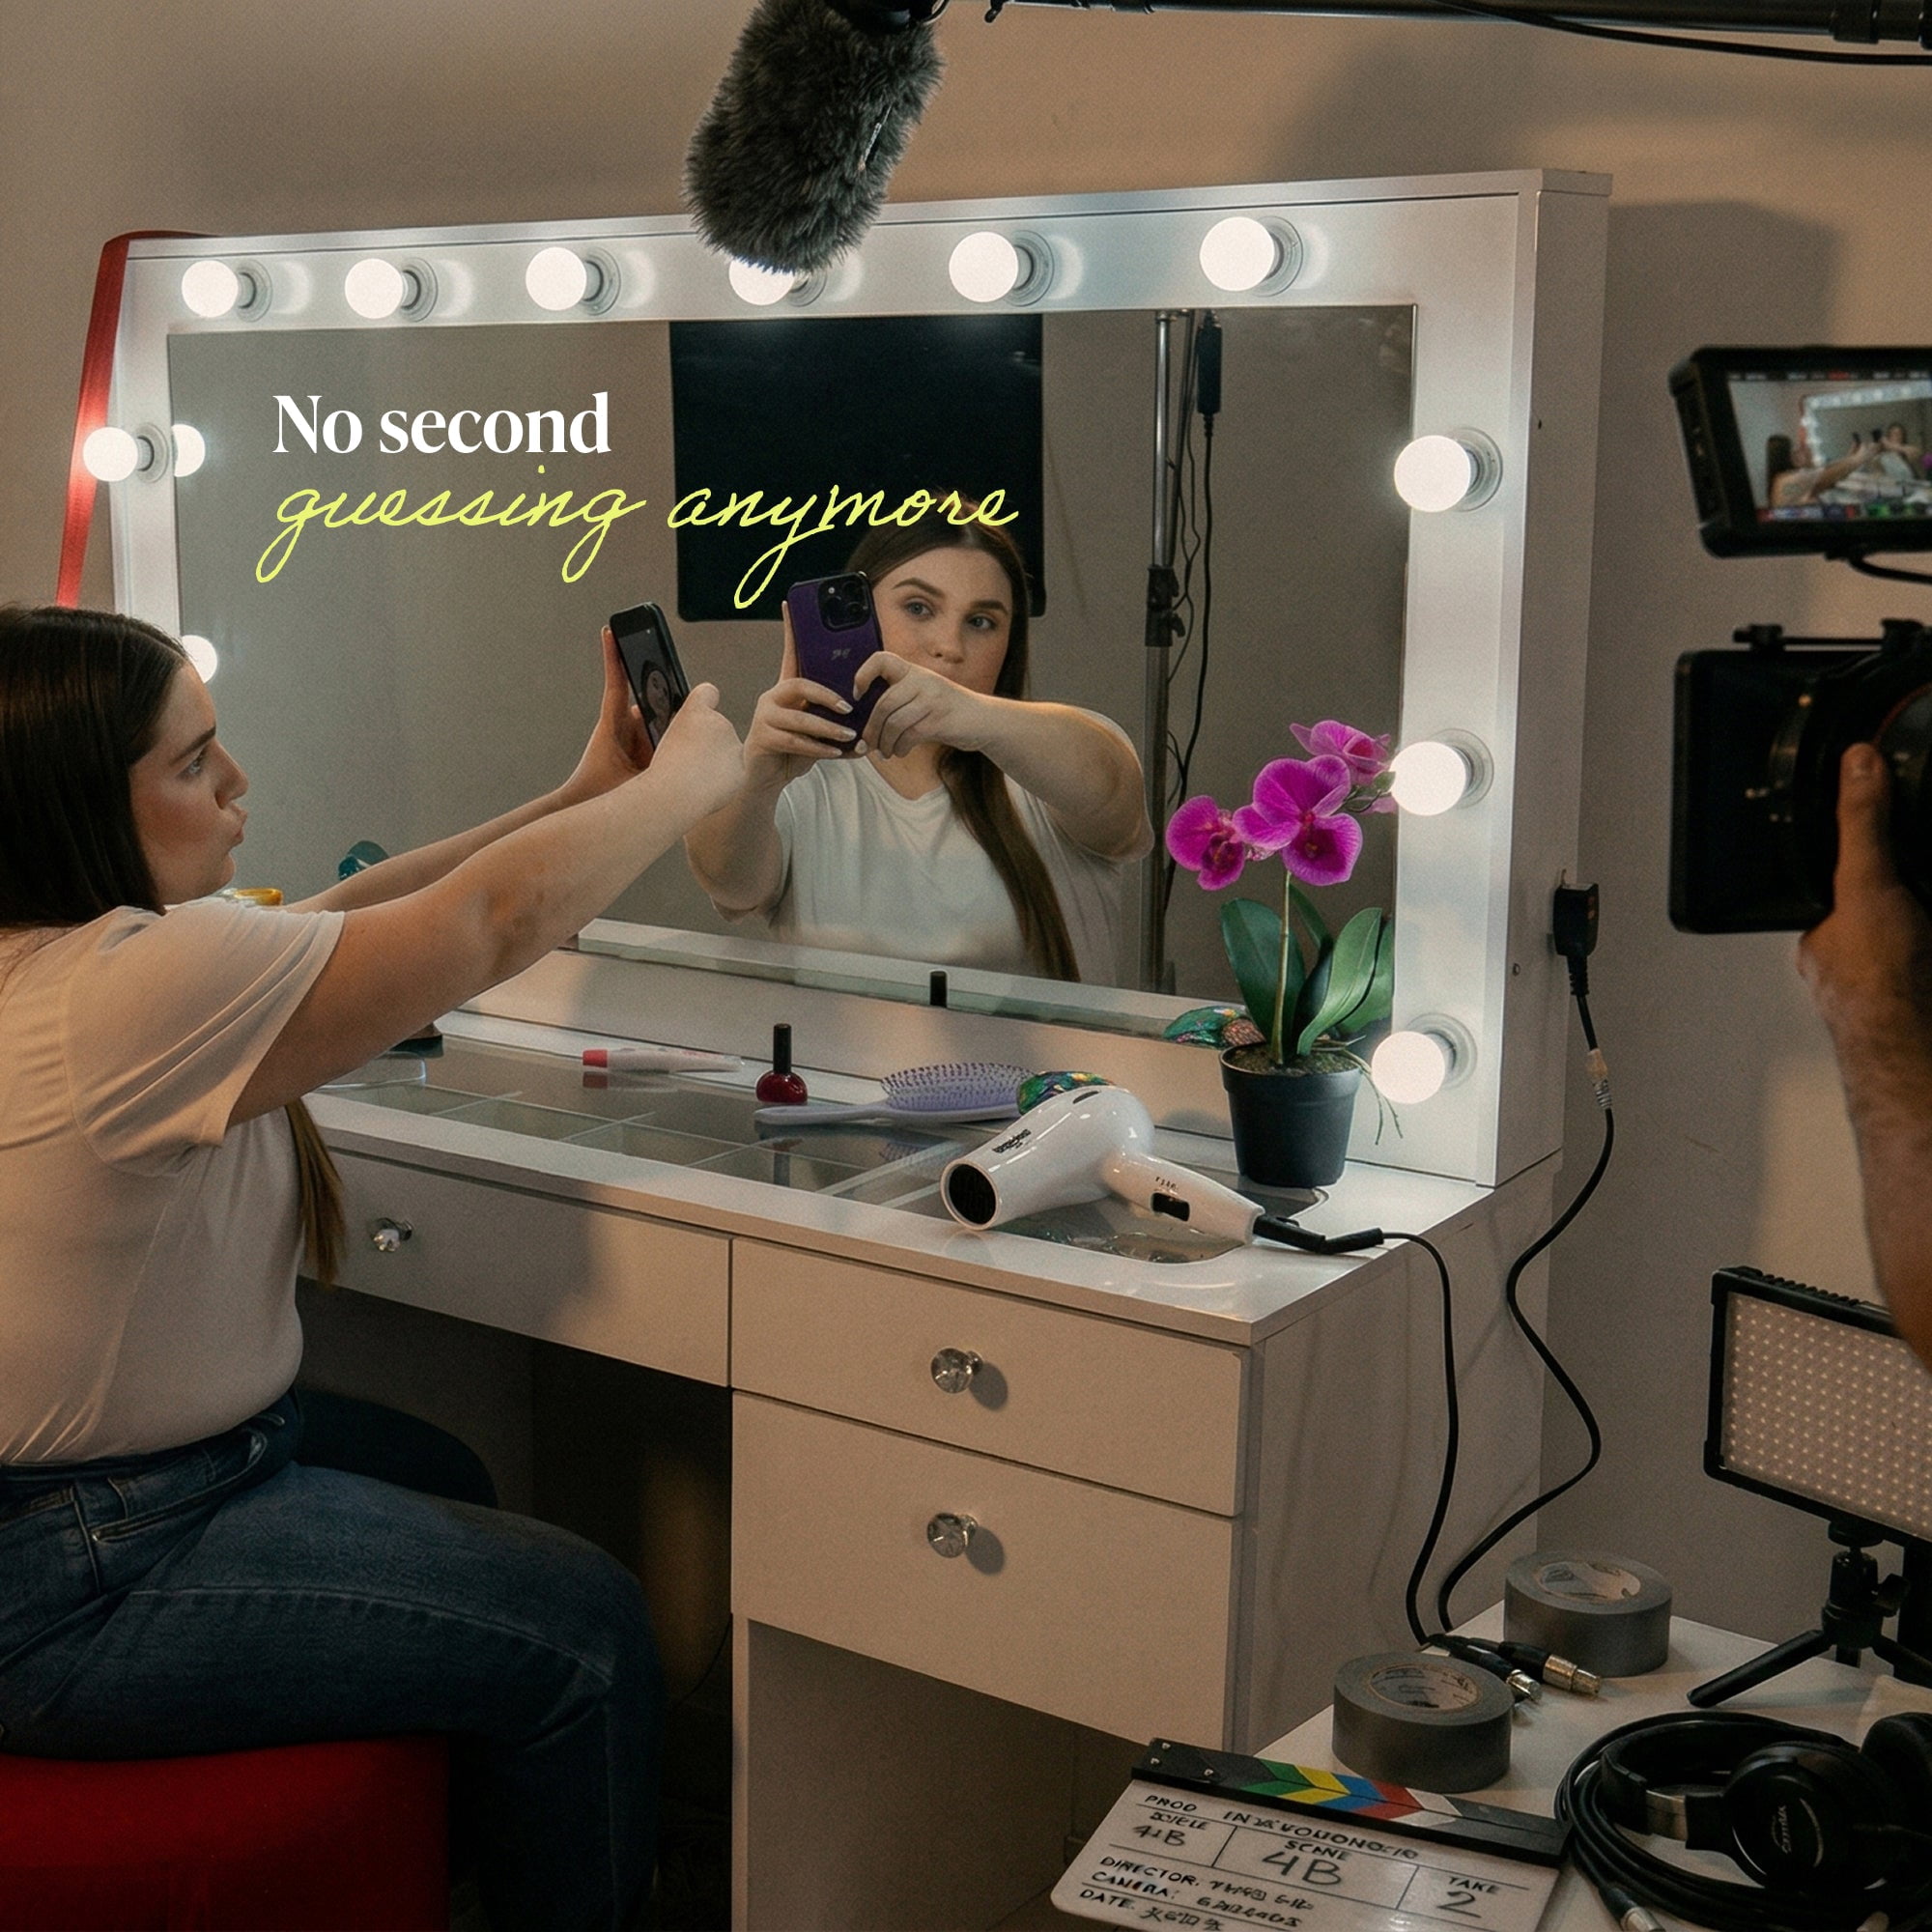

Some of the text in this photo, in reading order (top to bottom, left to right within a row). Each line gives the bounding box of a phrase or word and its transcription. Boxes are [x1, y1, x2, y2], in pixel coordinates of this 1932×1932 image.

[1262, 1851, 1342, 1885] 4B
[1449, 1877, 1499, 1894] TAKE
[1436, 1890, 1482, 1918] 2
